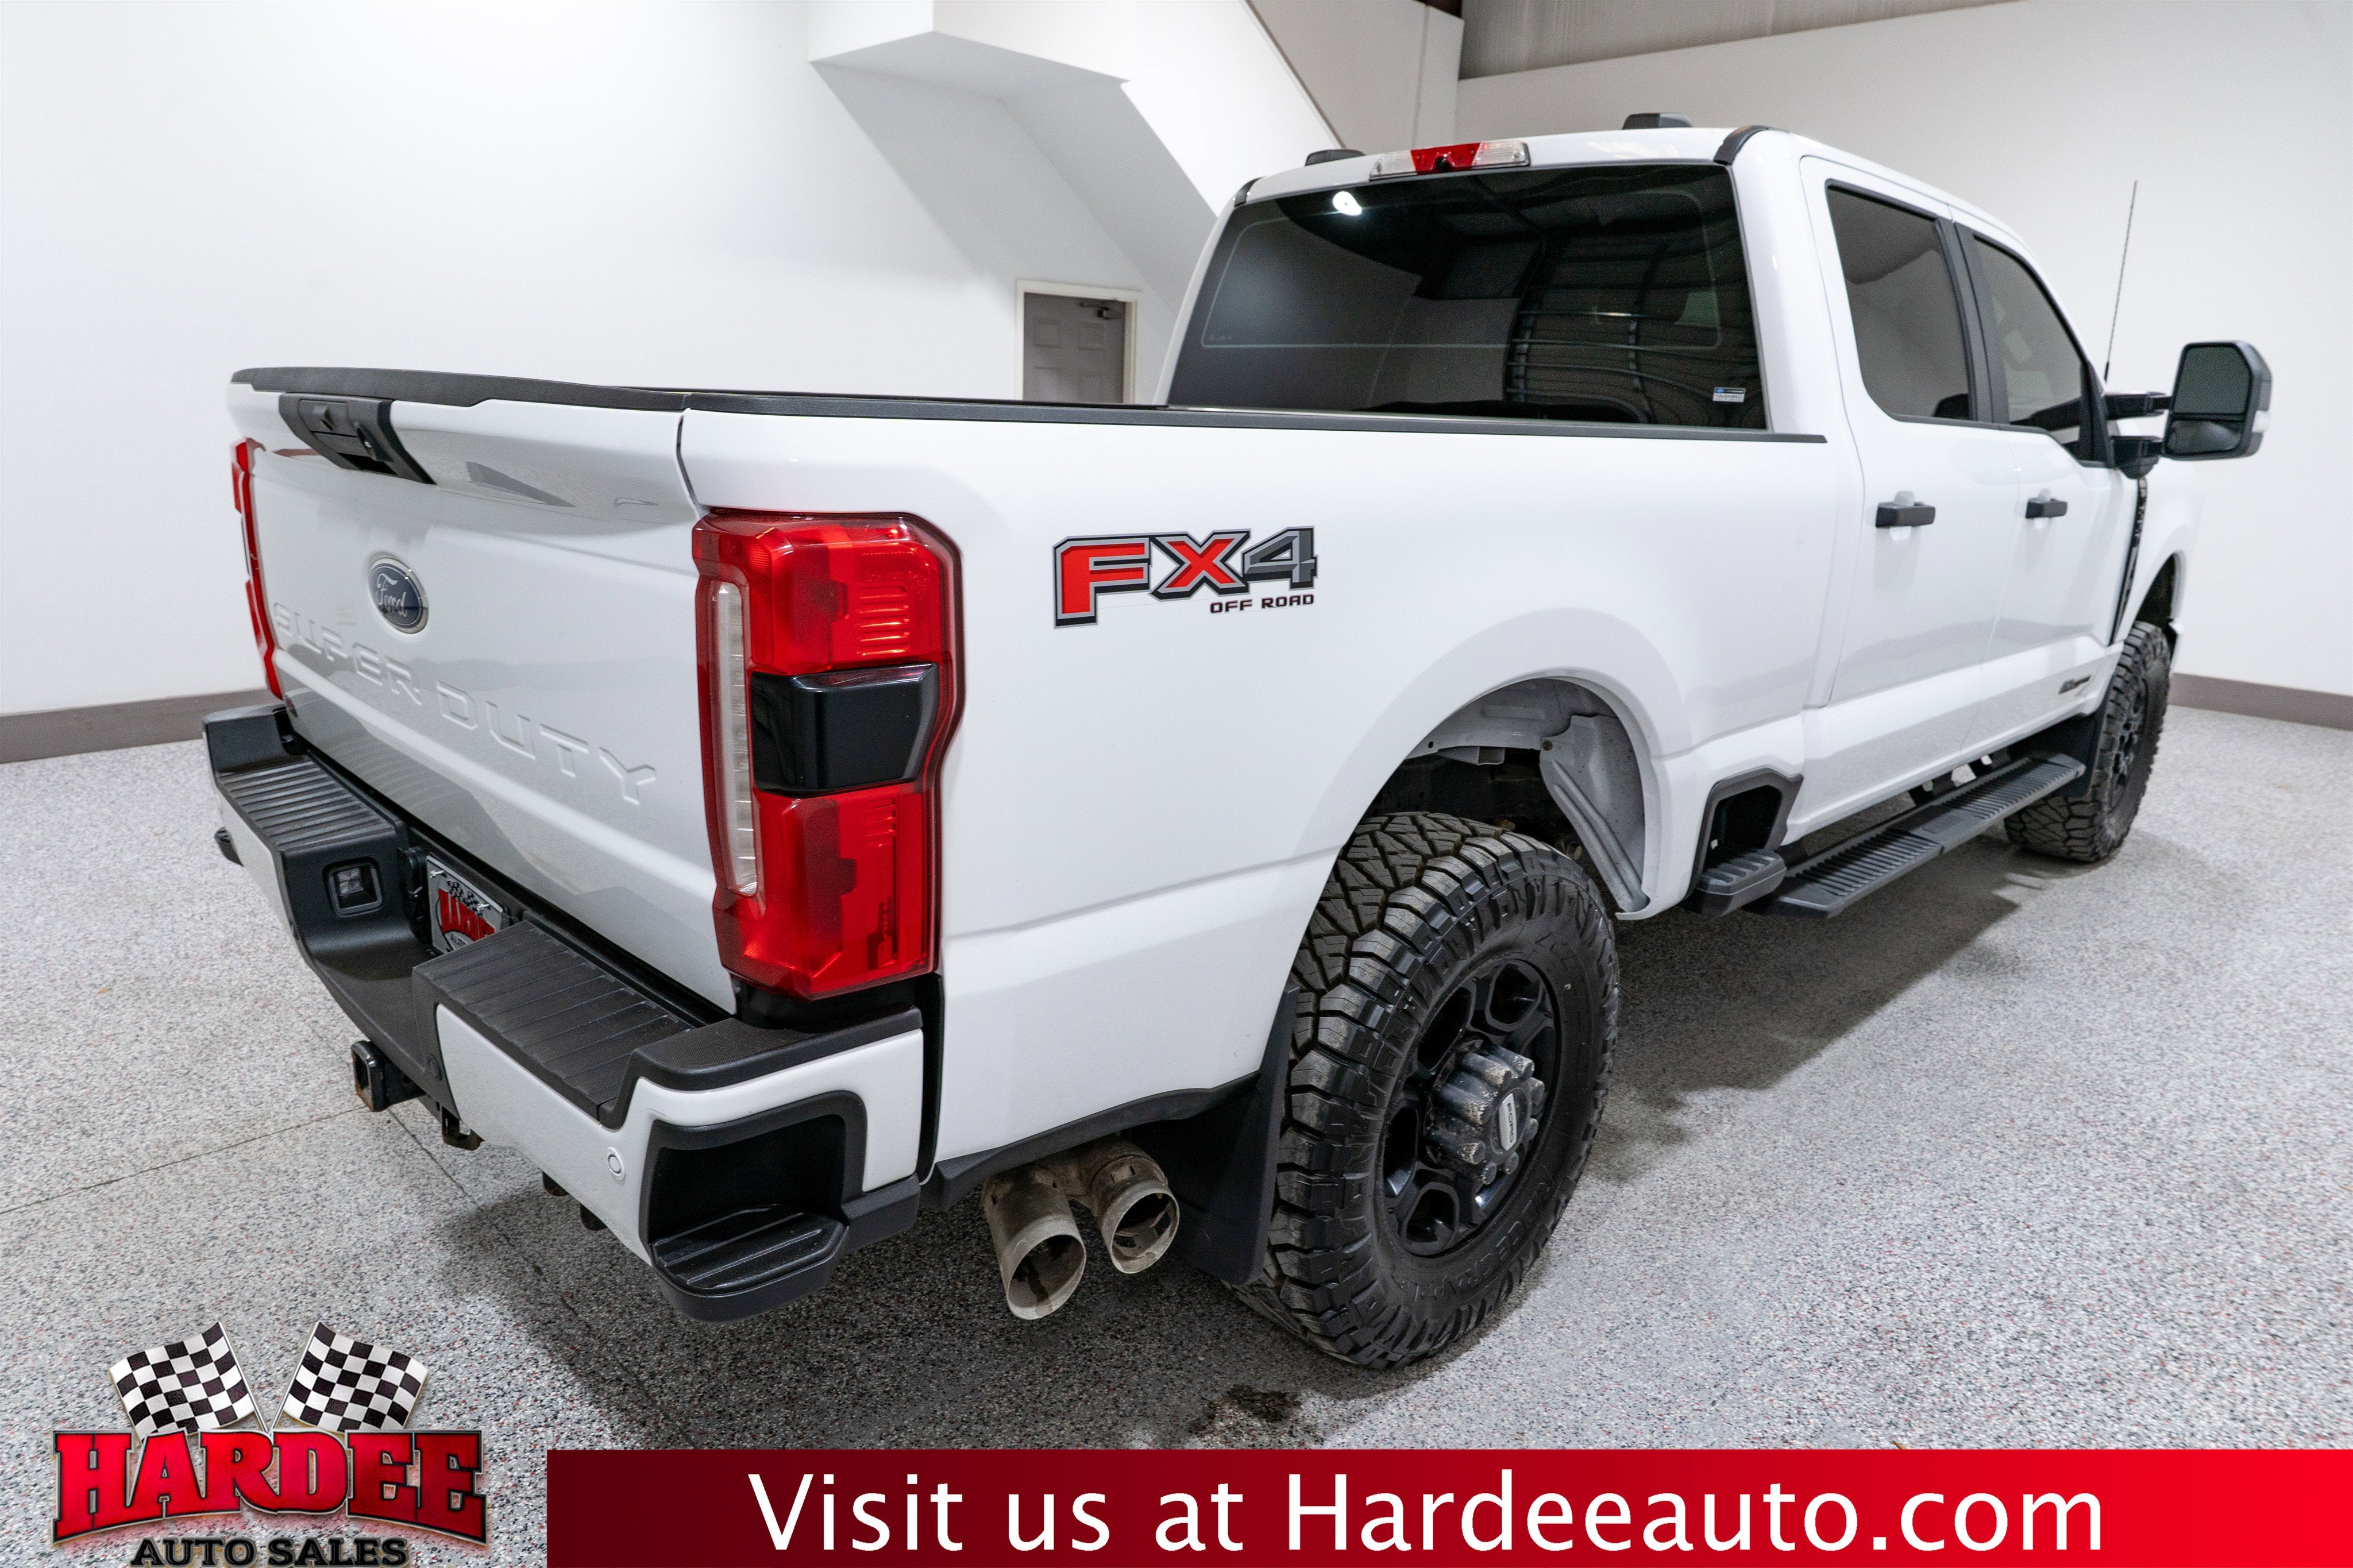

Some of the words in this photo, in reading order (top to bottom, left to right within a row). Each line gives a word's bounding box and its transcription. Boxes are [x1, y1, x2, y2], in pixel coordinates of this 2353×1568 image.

[1052, 525, 1318, 629] FX4
[1210, 599, 1252, 614] OFF
[1261, 593, 1315, 609] ROAD
[274, 602, 423, 706] SUPER
[437, 679, 656, 806] DUTY
